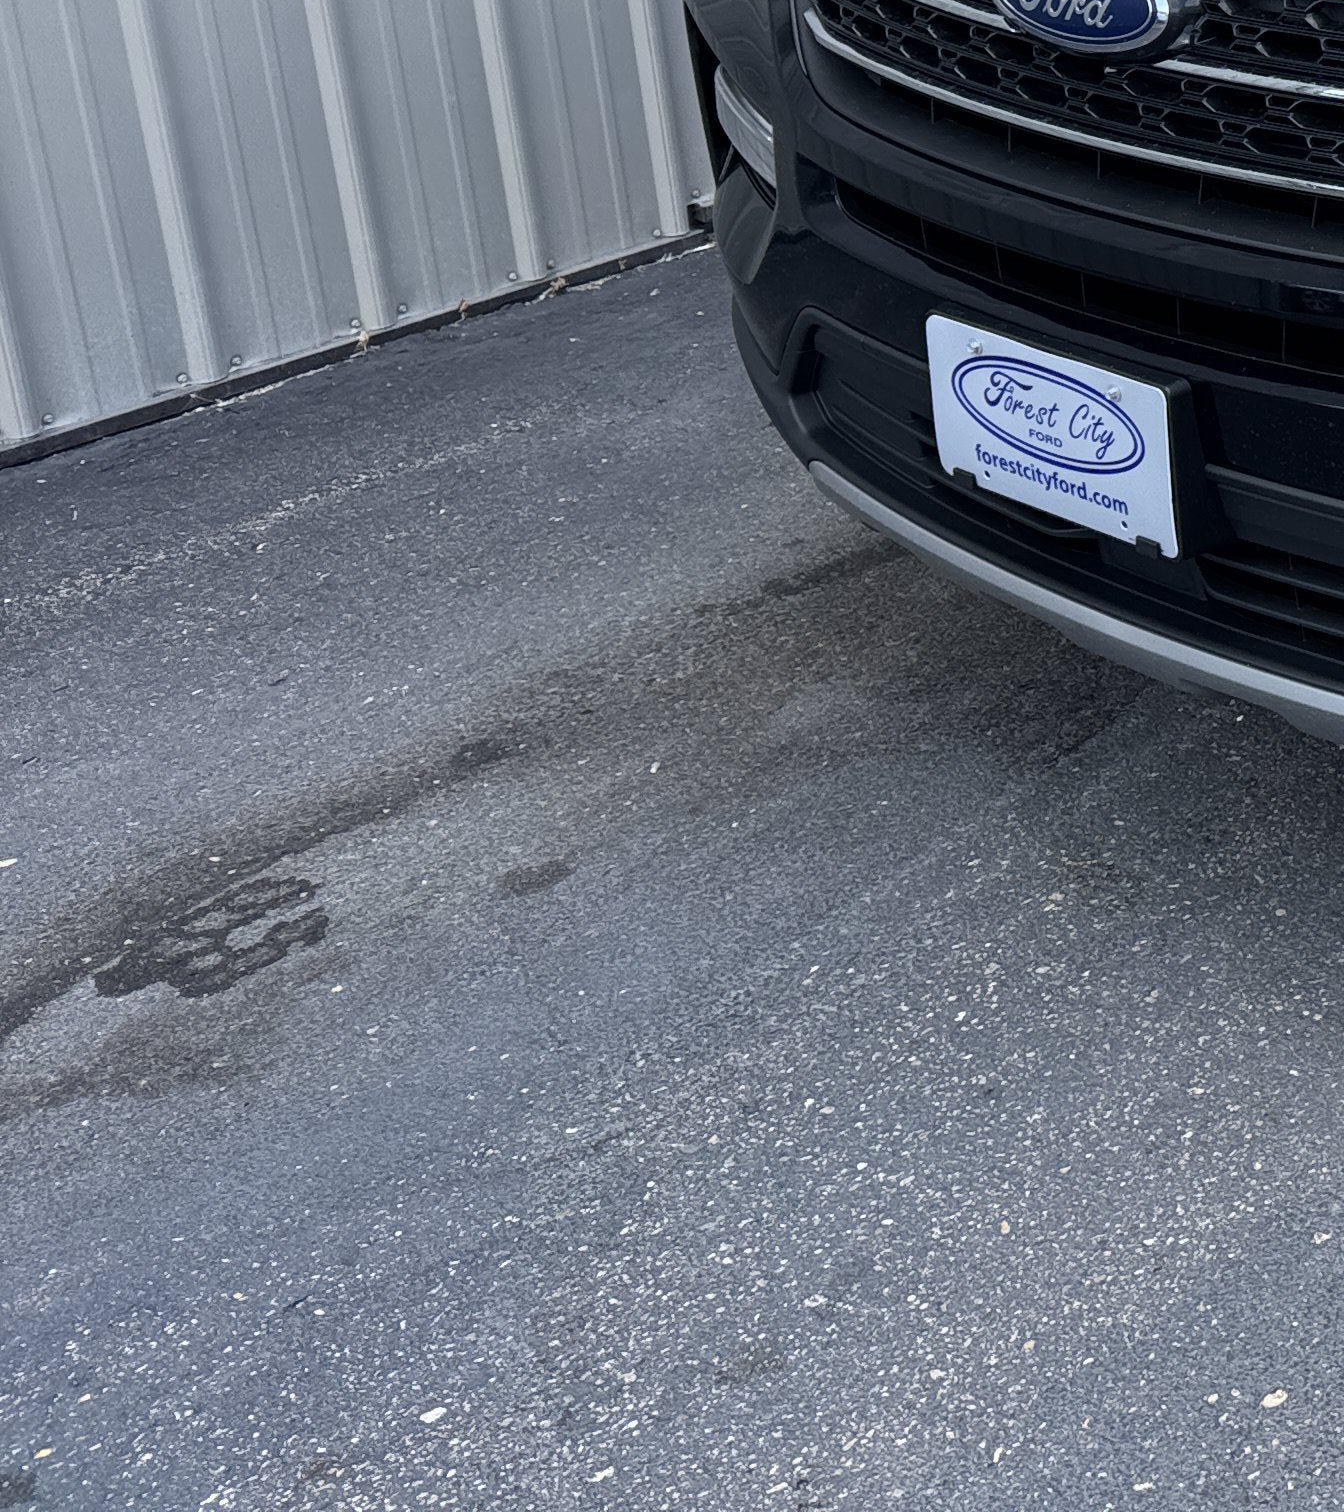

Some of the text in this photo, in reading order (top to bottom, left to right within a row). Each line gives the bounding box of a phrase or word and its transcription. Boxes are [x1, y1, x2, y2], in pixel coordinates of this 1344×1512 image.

[983, 370, 1117, 460] Forest City
[1028, 428, 1064, 449] FORD
[974, 444, 1129, 517] forestcityford.com
